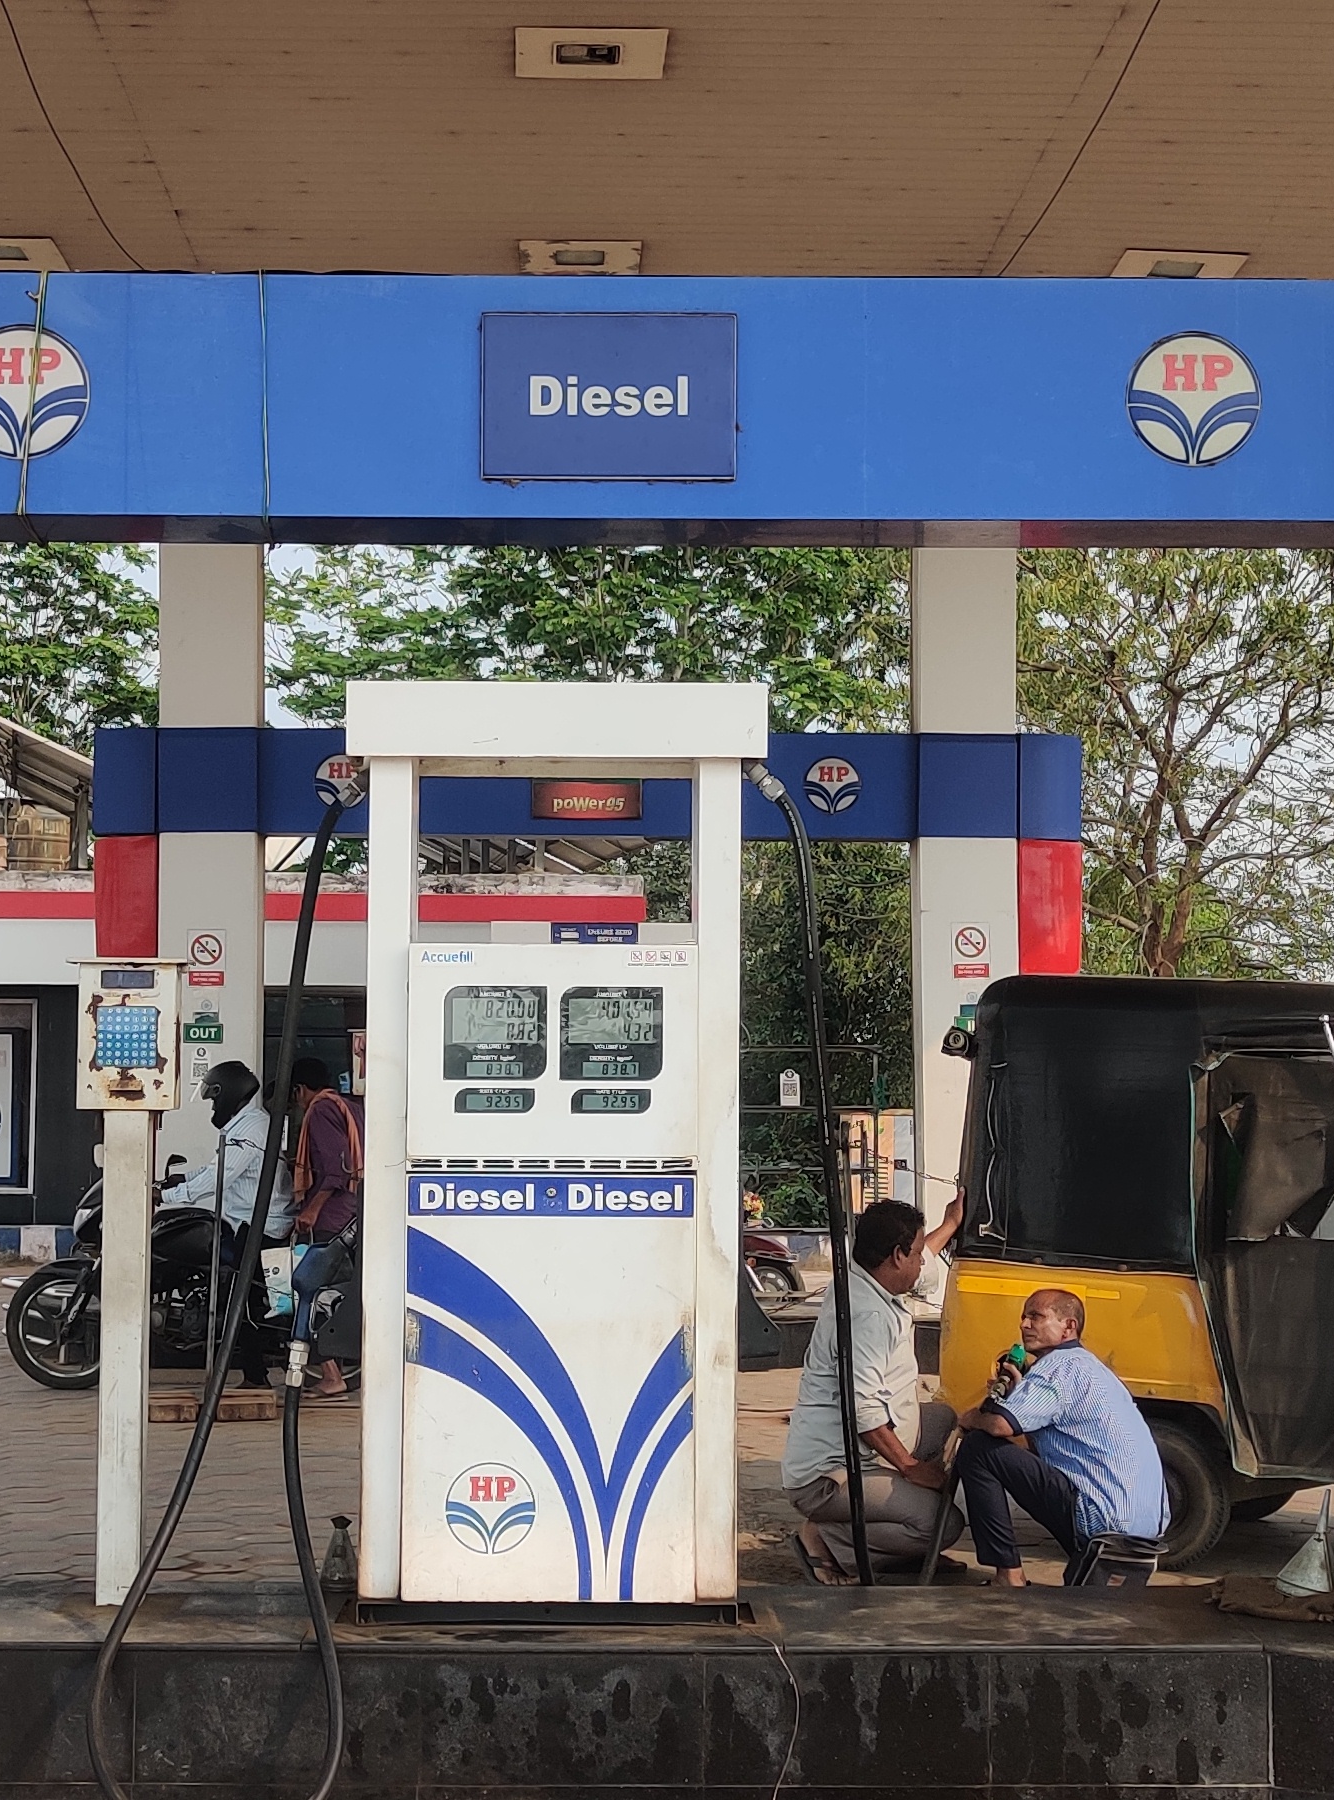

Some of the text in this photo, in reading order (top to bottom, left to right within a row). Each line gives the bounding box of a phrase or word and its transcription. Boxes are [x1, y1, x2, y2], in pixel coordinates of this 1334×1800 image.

[1162, 354, 1234, 391] HP
[529, 375, 689, 417] Diesel
[818, 766, 850, 782] HP
[421, 950, 473, 963] Accuefill
[189, 1027, 218, 1039] OUT
[419, 1182, 683, 1212] Diesel Diesel
[469, 1476, 517, 1502] HP
